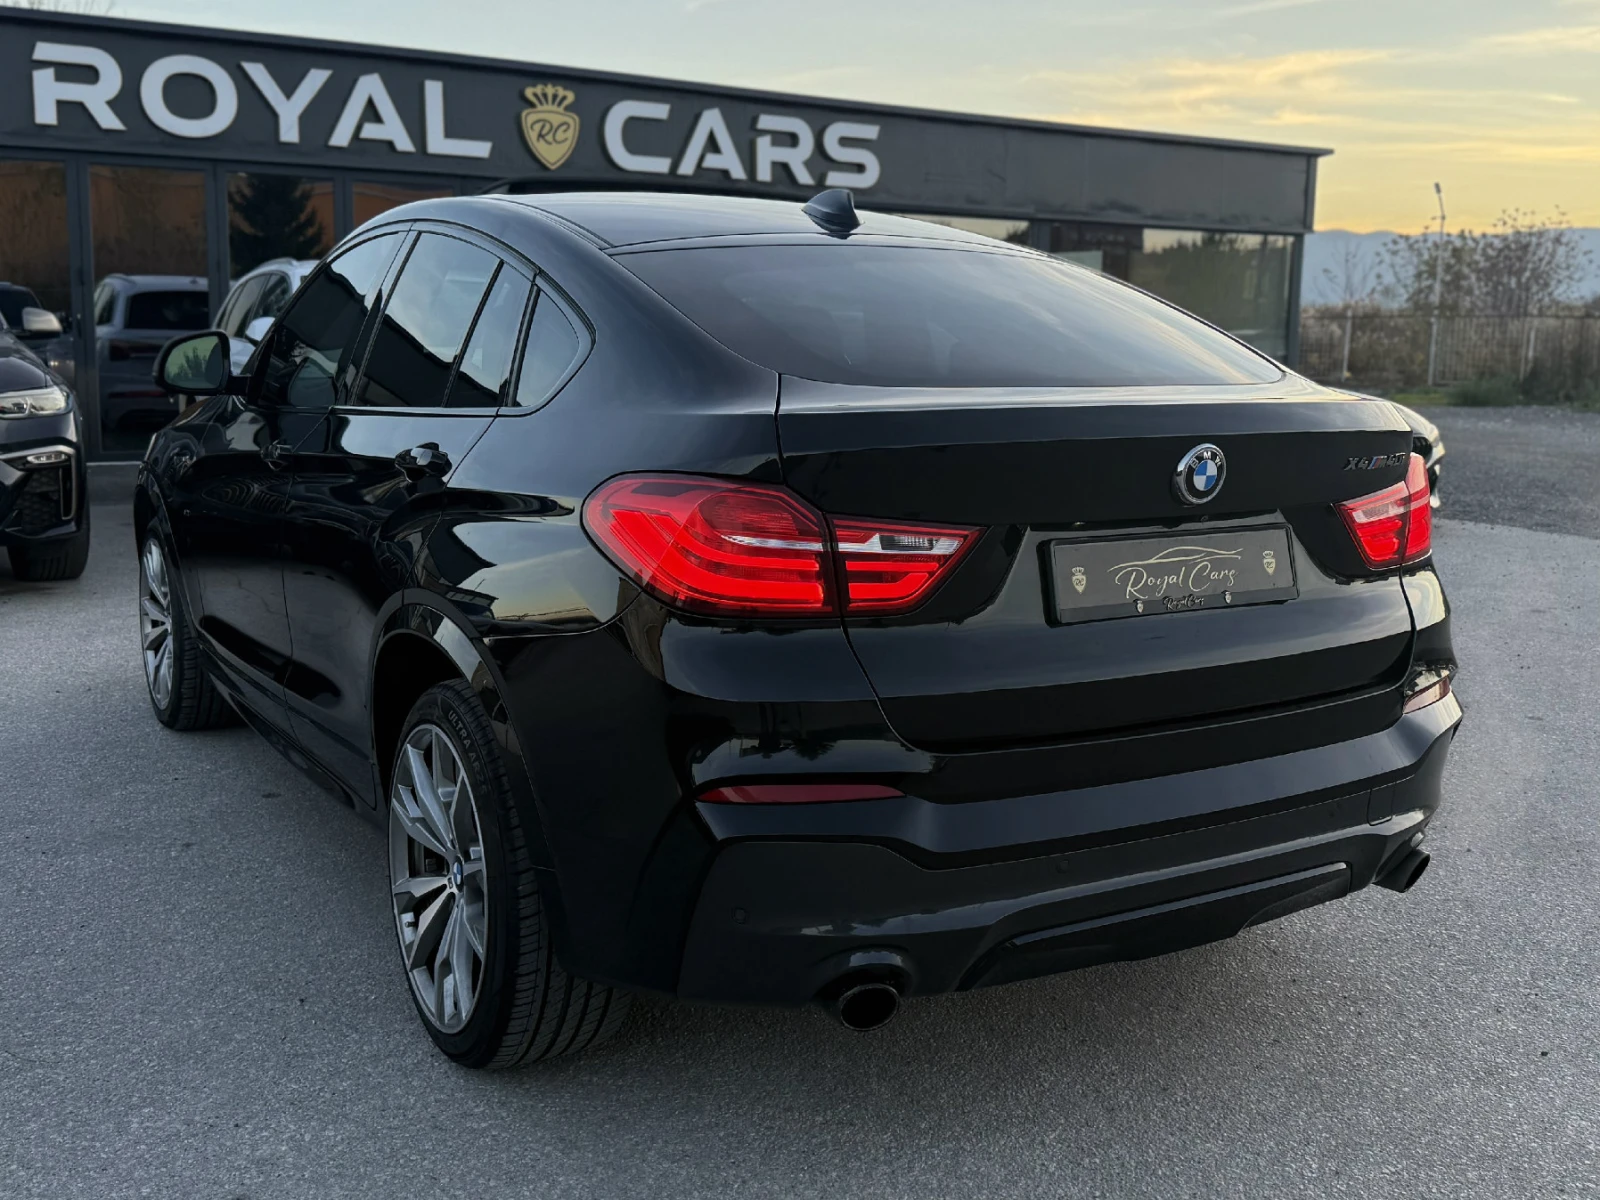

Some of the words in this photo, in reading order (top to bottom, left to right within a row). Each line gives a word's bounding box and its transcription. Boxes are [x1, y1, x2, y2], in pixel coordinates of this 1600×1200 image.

[32, 41, 492, 158] ROYAL
[530, 118, 570, 145] RC
[604, 100, 881, 189] CARS
[1189, 451, 1222, 468] BMW
[1115, 567, 1186, 599] Royal
[1189, 562, 1239, 591] Cars
[448, 710, 471, 749] ULTRA
